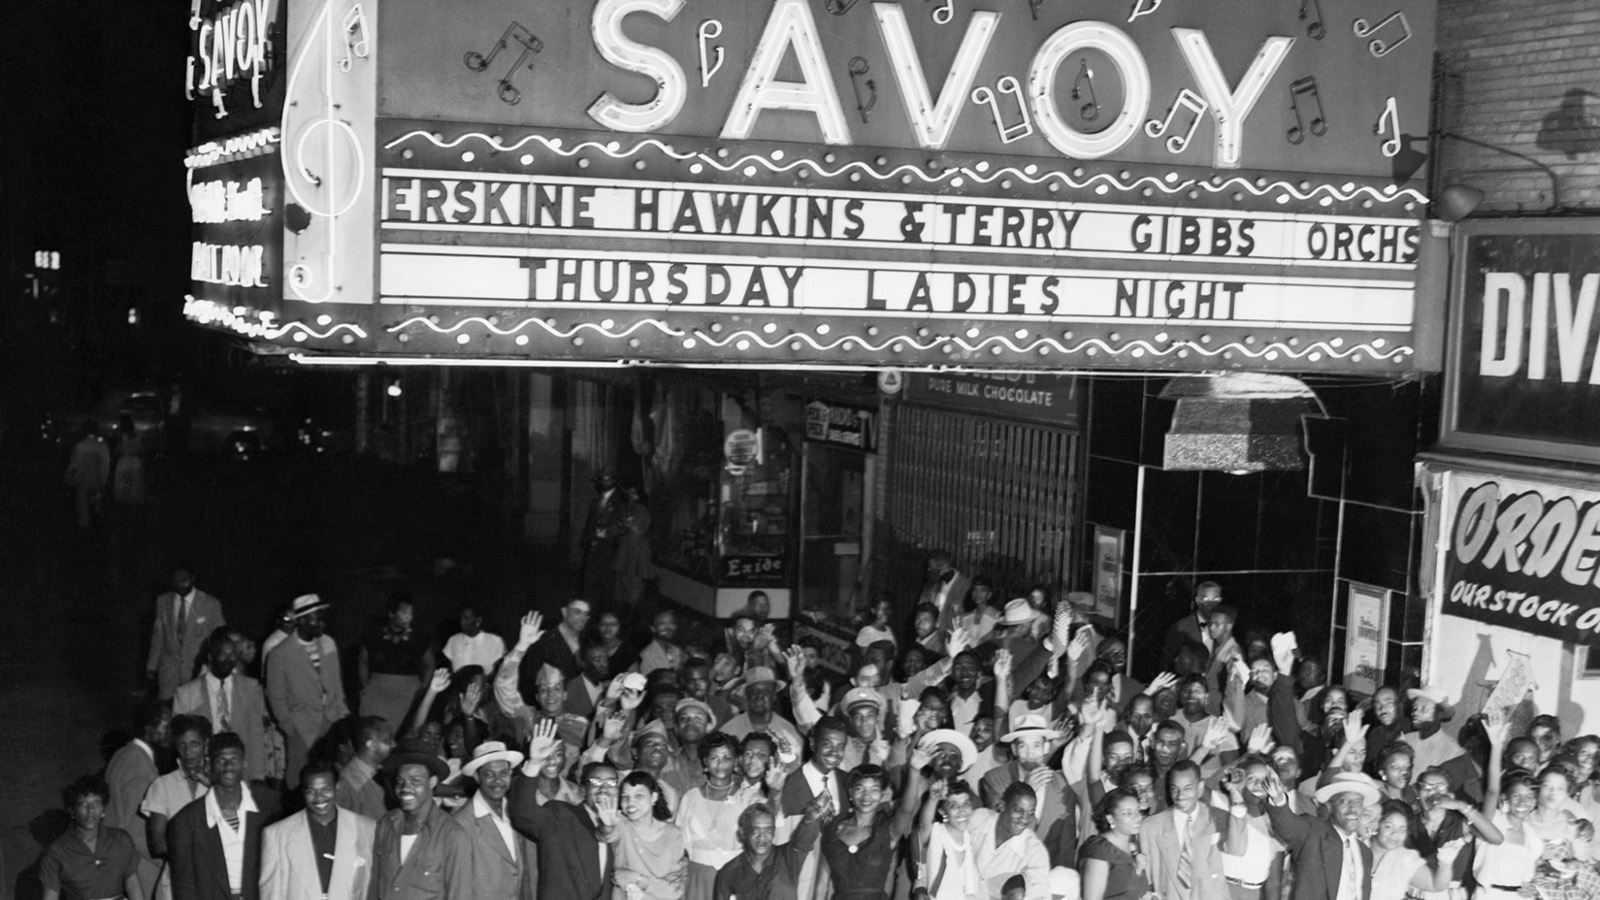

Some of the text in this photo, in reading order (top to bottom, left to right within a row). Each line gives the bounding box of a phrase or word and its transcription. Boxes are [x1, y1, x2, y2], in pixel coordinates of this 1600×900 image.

[587, 0, 1297, 169] SAVOY
[387, 179, 1420, 265] ERSKINE HAWKINS & TERRY GIBBS ORCHS
[519, 257, 1244, 322] THURSDAY LADIES NIGHT
[1480, 272, 1600, 385] DIV
[928, 377, 952, 394] PURE
[956, 381, 980, 398] MILK
[984, 384, 1054, 407] CHOCOLATE
[727, 557, 782, 577] Exide
[1455, 480, 1600, 589] ORDE
[1450, 580, 1492, 609] OUR
[1488, 590, 1580, 627] STOCK
